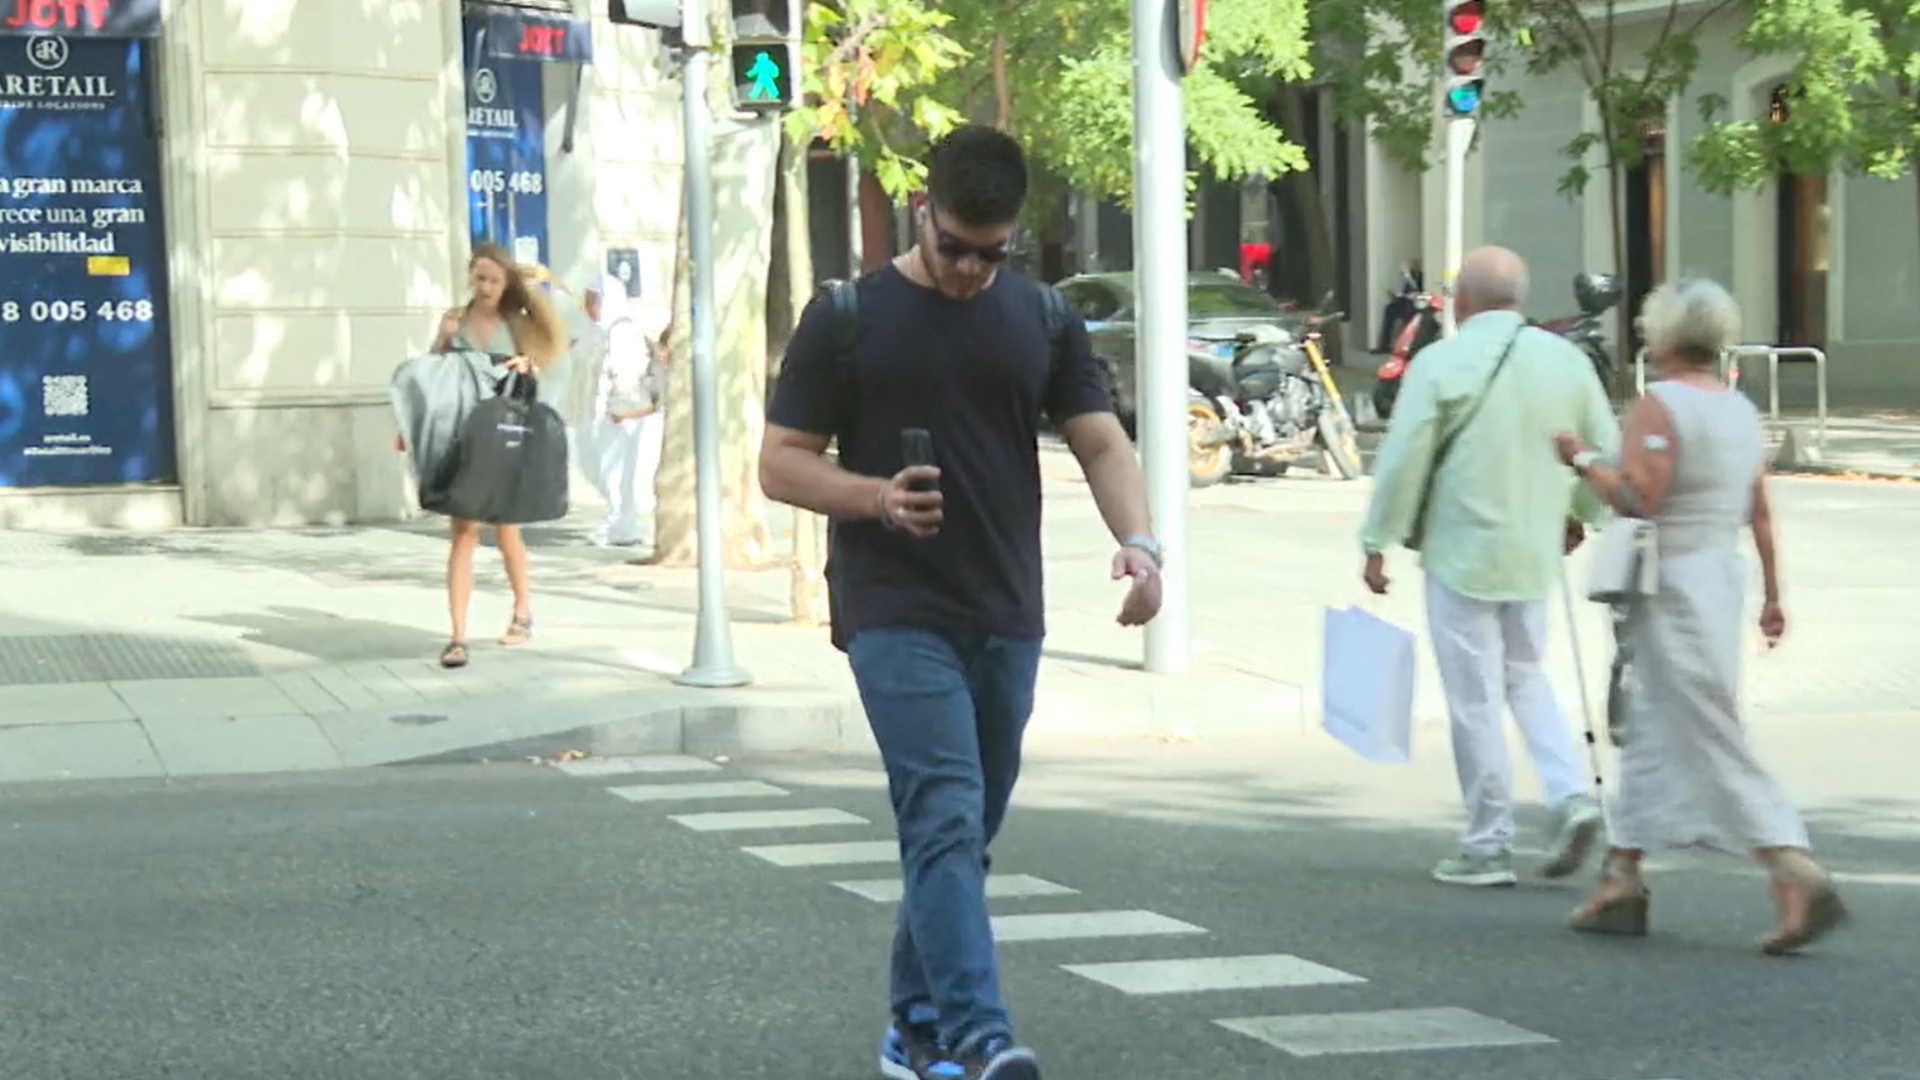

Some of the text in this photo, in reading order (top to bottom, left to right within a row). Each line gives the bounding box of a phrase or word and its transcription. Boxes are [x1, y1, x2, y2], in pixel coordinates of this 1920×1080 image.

[5, 0, 110, 29] JOTT
[11, 177, 67, 199] gran
[71, 178, 143, 193] marca
[470, 169, 543, 195] 005 468
[46, 208, 87, 224] una
[91, 207, 145, 229] gran
[0, 231, 116, 253] visibilidad
[30, 299, 87, 322] 005
[96, 299, 154, 322] 468
